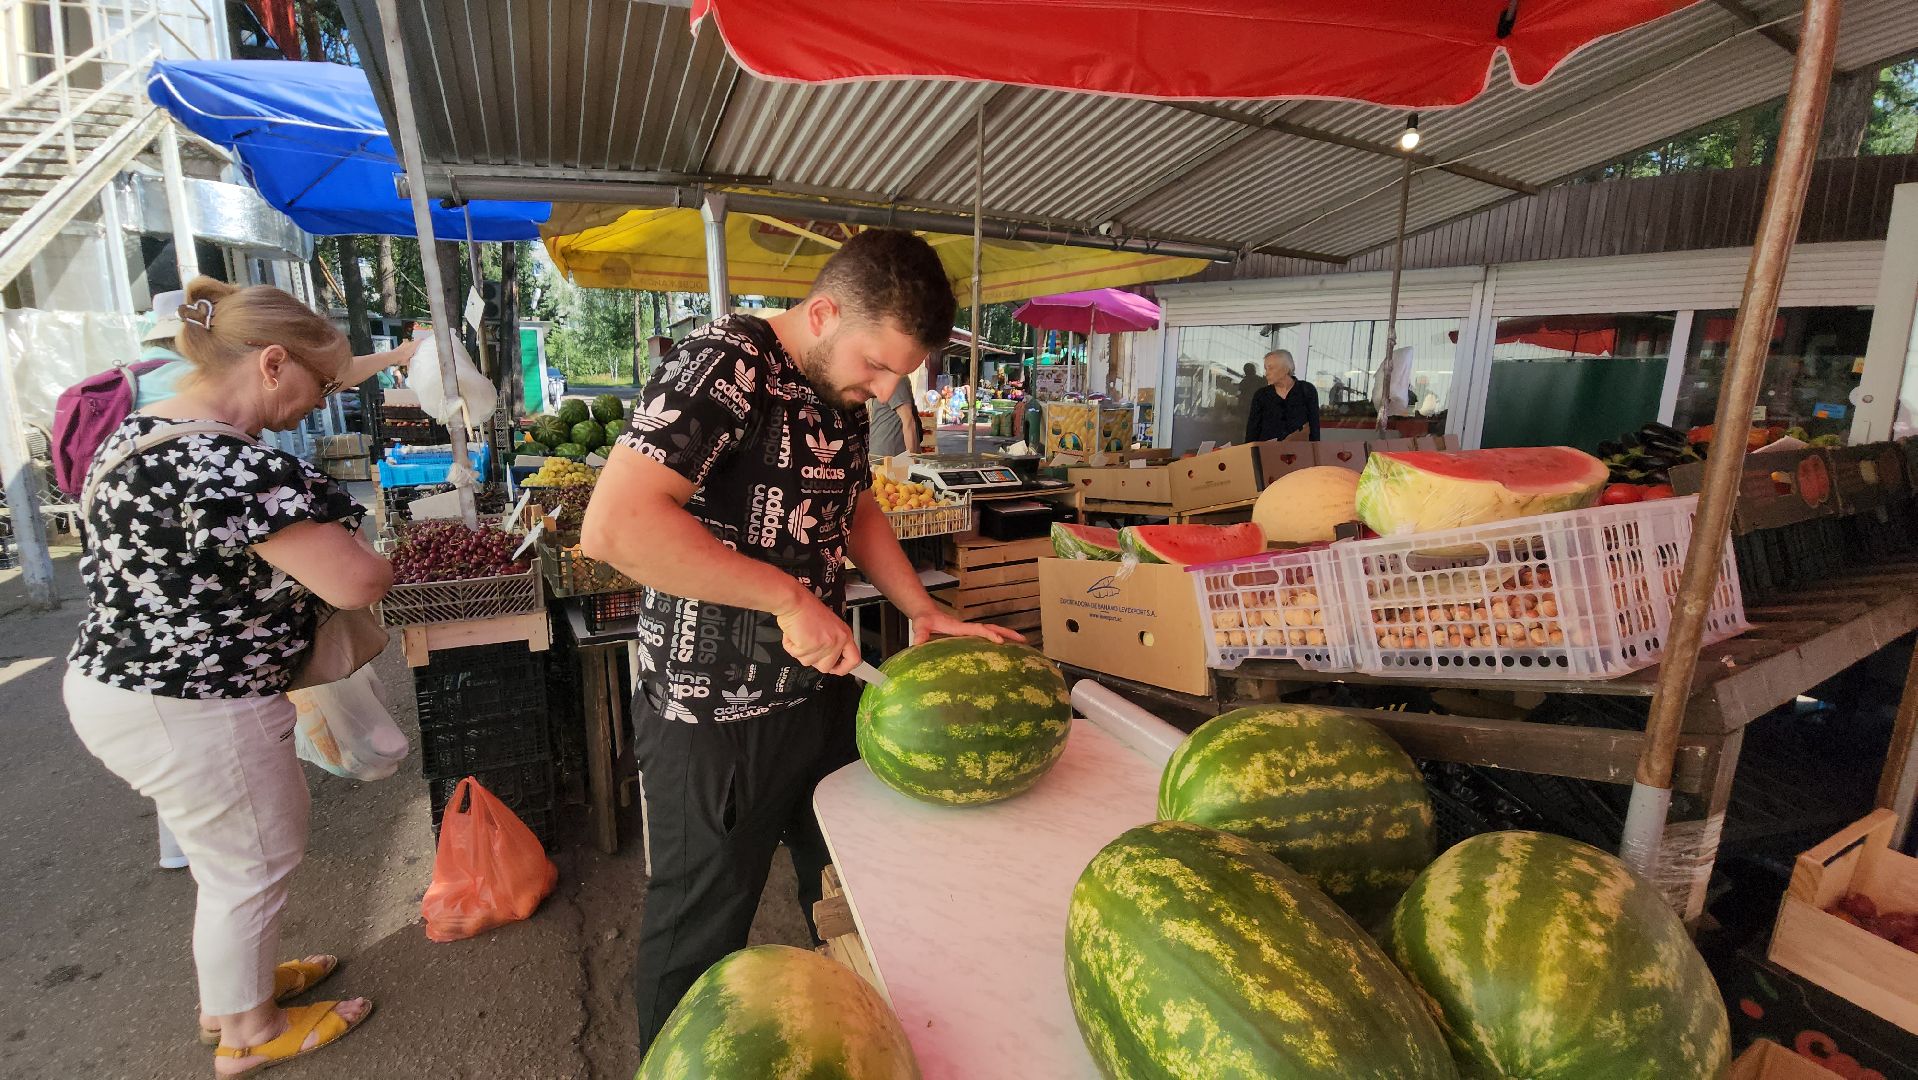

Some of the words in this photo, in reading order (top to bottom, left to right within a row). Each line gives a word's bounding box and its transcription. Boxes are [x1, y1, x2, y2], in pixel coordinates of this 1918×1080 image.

[675, 347, 714, 393] adidas
[714, 378, 751, 413] adidas
[615, 431, 667, 465] didas
[801, 465, 846, 480] adidas
[760, 486, 785, 549] adidas
[698, 605, 728, 665] didas
